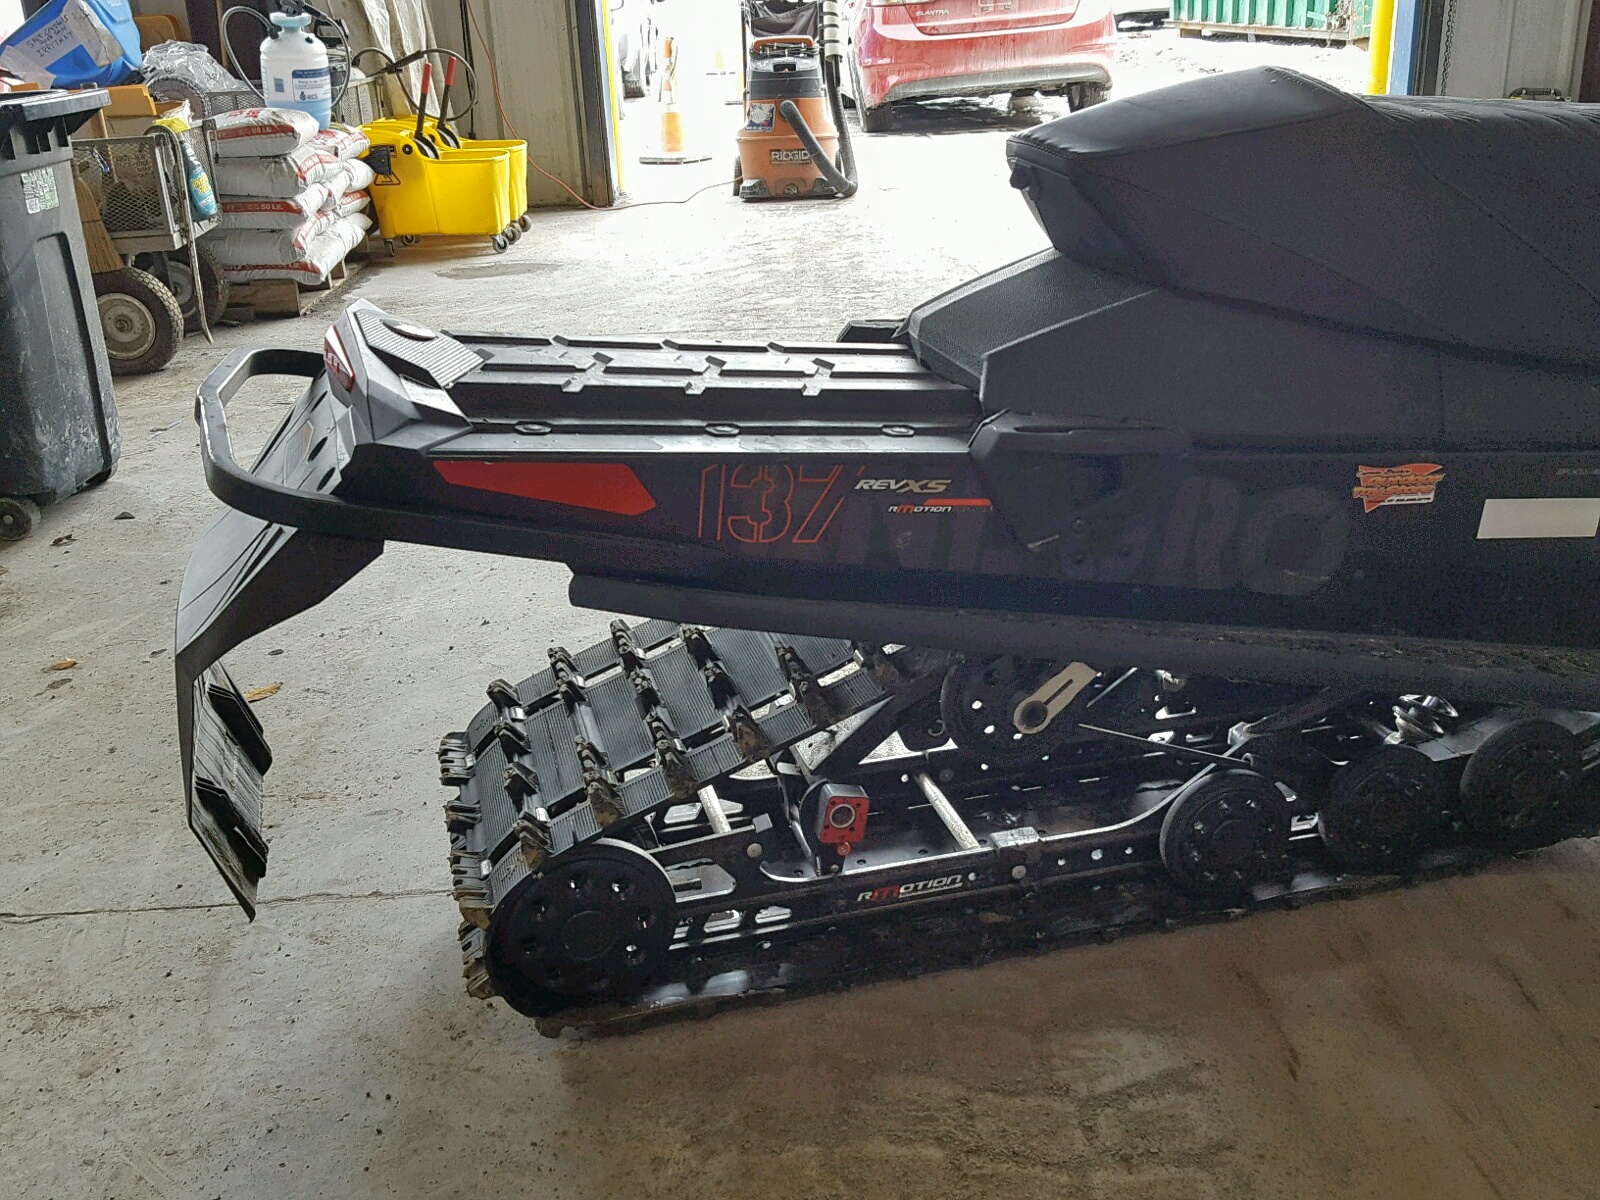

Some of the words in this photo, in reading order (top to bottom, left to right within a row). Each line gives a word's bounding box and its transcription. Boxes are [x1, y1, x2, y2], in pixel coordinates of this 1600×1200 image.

[916, 9, 950, 17] ELANTRA
[771, 151, 810, 161] RIDGID
[698, 463, 844, 544] 137
